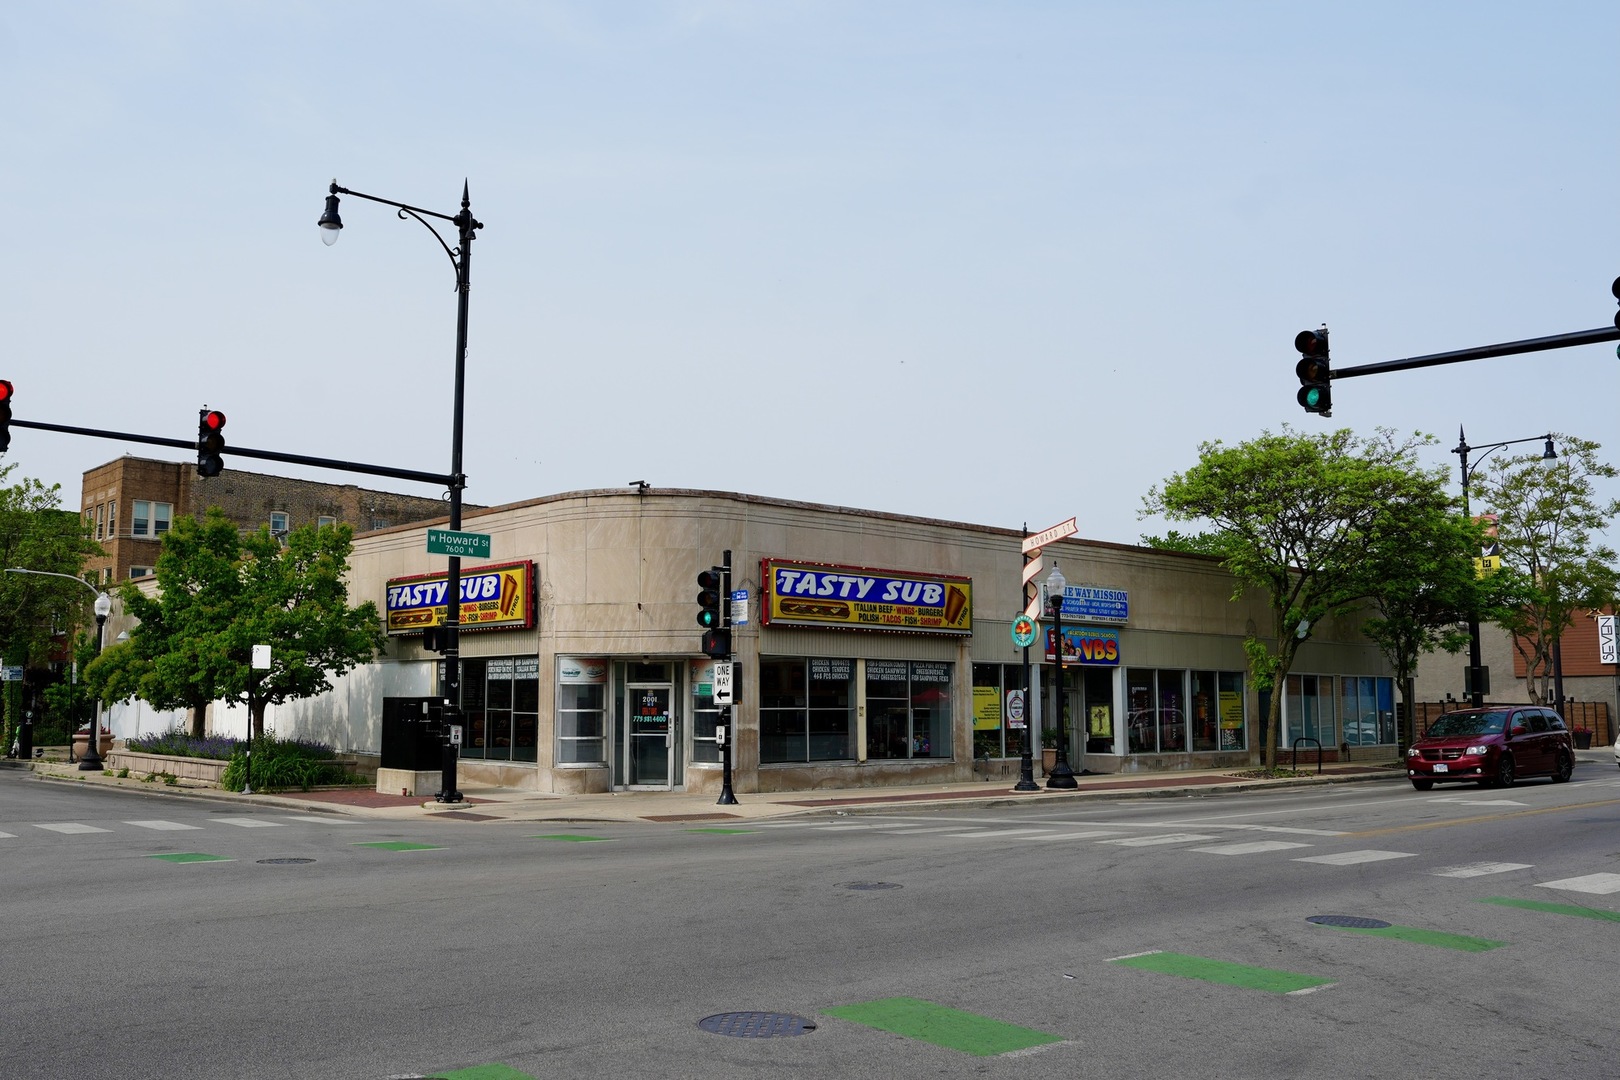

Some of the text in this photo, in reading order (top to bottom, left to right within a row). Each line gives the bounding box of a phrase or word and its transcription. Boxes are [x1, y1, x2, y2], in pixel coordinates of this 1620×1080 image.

[439, 533, 479, 546] Howard
[1030, 529, 1058, 547] HOWARD
[445, 545, 464, 553] 7600
[779, 571, 943, 604] TASTY SUB
[389, 582, 448, 607] TASTY
[1075, 588, 1092, 598] WAY
[1093, 589, 1128, 601] MISSION
[463, 604, 477, 613] WINGS
[479, 601, 499, 611] BURGERS
[510, 595, 520, 616] GYROS
[853, 603, 944, 617] ITALIAN BEEF WINGS BURGERS
[468, 613, 478, 622] FISH
[480, 612, 497, 621] SHRIMP
[858, 613, 943, 626] POLISH TACOS FISH SHRIMP
[957, 606, 969, 626] GYROS
[1600, 617, 1614, 661] SEVEN
[1080, 638, 1118, 661] VBS
[717, 665, 730, 675] ONE
[717, 677, 730, 686] WAY
